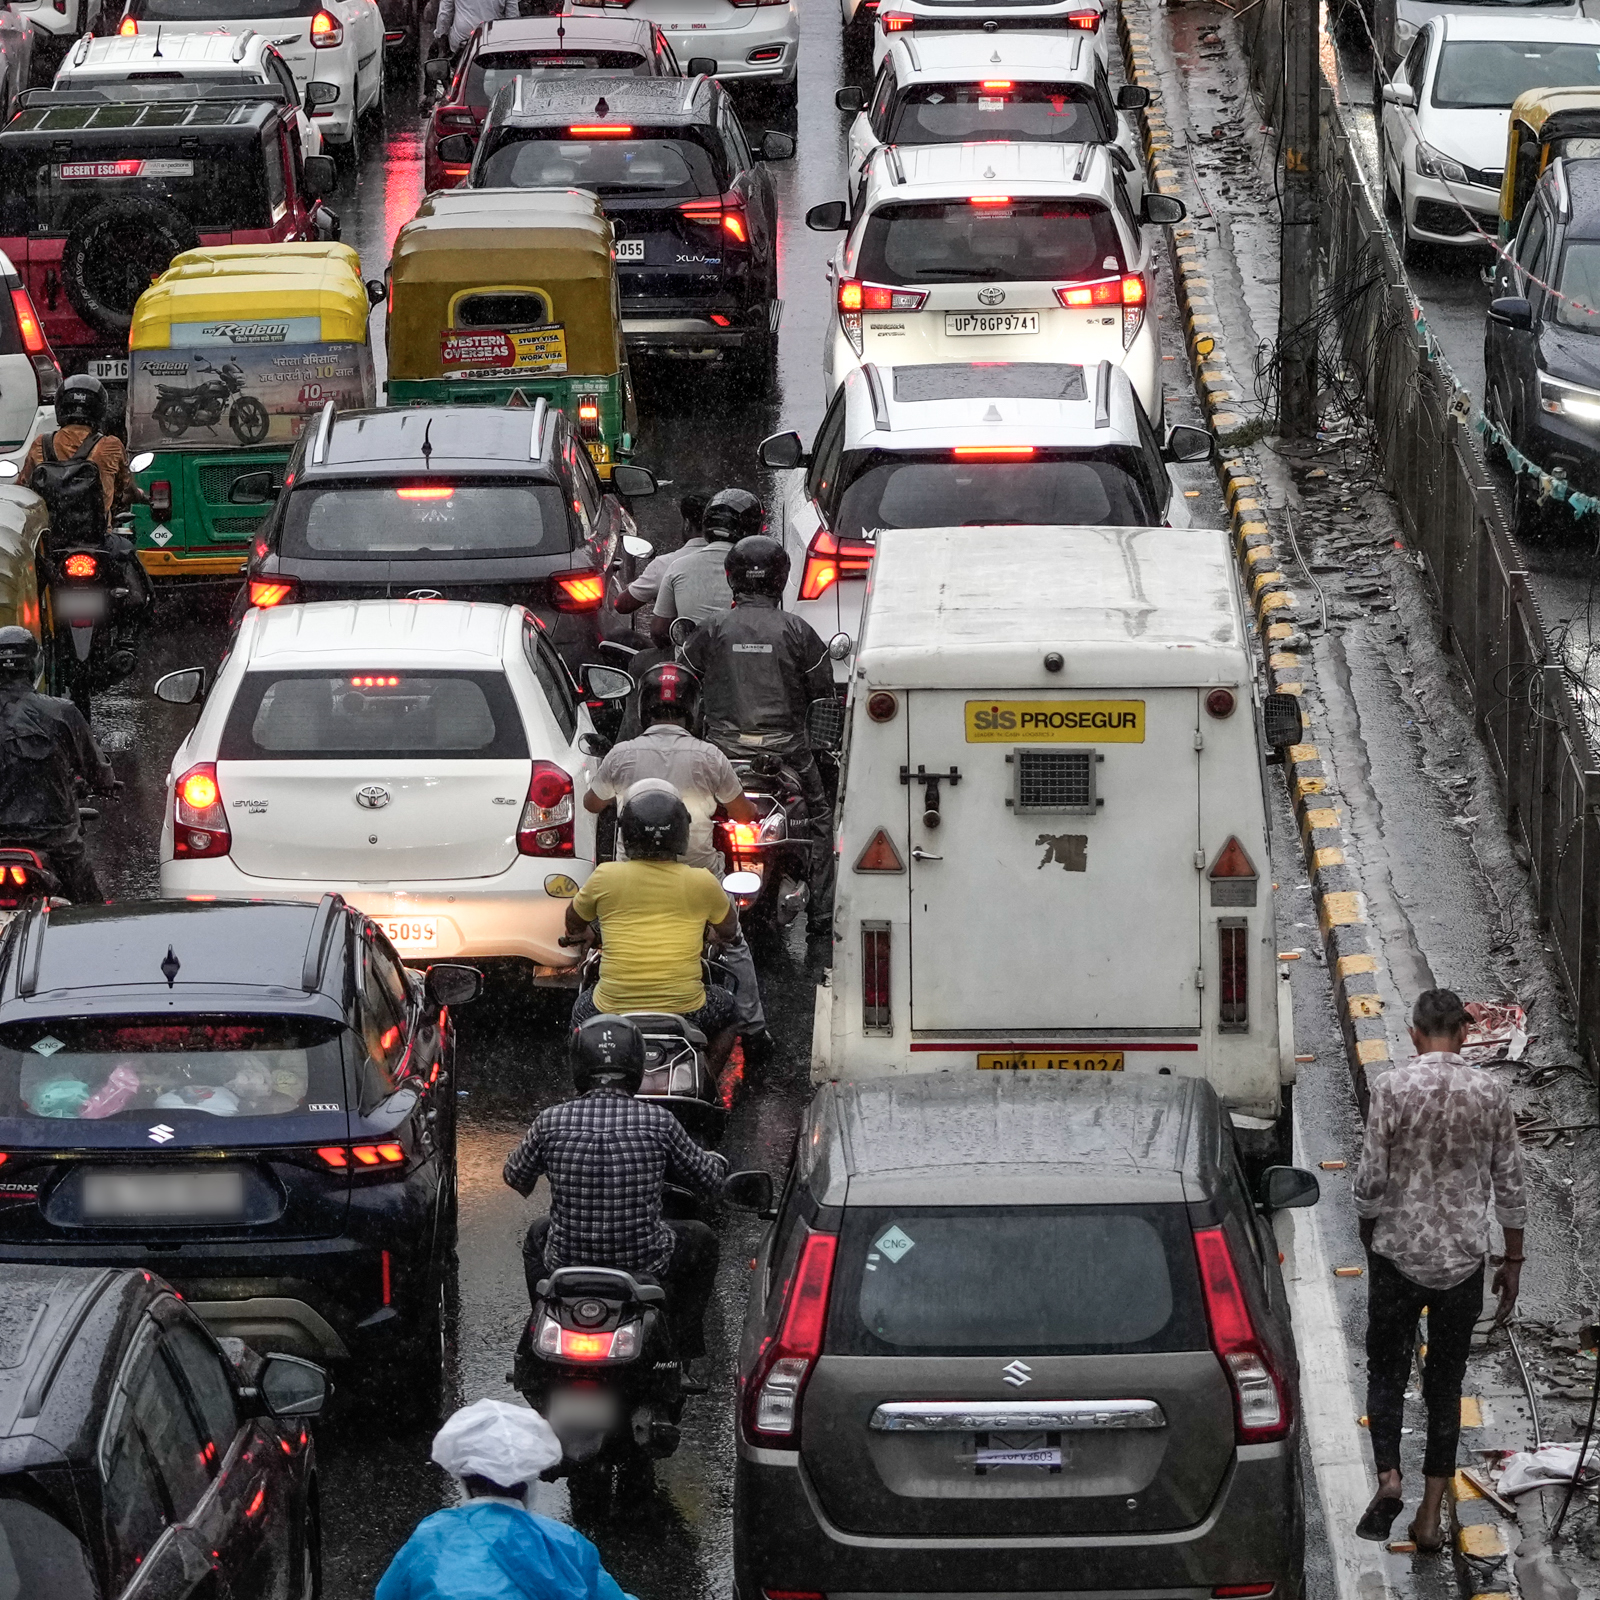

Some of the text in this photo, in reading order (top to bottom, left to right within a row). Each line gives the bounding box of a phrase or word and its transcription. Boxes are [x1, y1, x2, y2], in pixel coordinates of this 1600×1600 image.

[62, 166, 95, 178] DESERT
[97, 164, 132, 176] ESCAPE
[212, 320, 290, 338] Radeon
[954, 315, 1037, 333] UP78GP9741
[446, 334, 560, 348] WESTERN STUDY VISA
[535, 344, 547, 352] PR
[443, 345, 510, 360] OVERSEAS
[520, 350, 563, 362] WORK VISA
[140, 361, 190, 371] Radeon
[272, 353, 300, 367] भरोसा
[316, 365, 335, 379] 10
[335, 367, 355, 378] साल
[302, 384, 322, 400] 10
[1020, 710, 1138, 731] PROSEGUR
[232, 799, 270, 808] ETIOS
[378, 922, 436, 941] 5099
[37, 1042, 59, 1050] CNG
[882, 1238, 908, 1250] CNG
